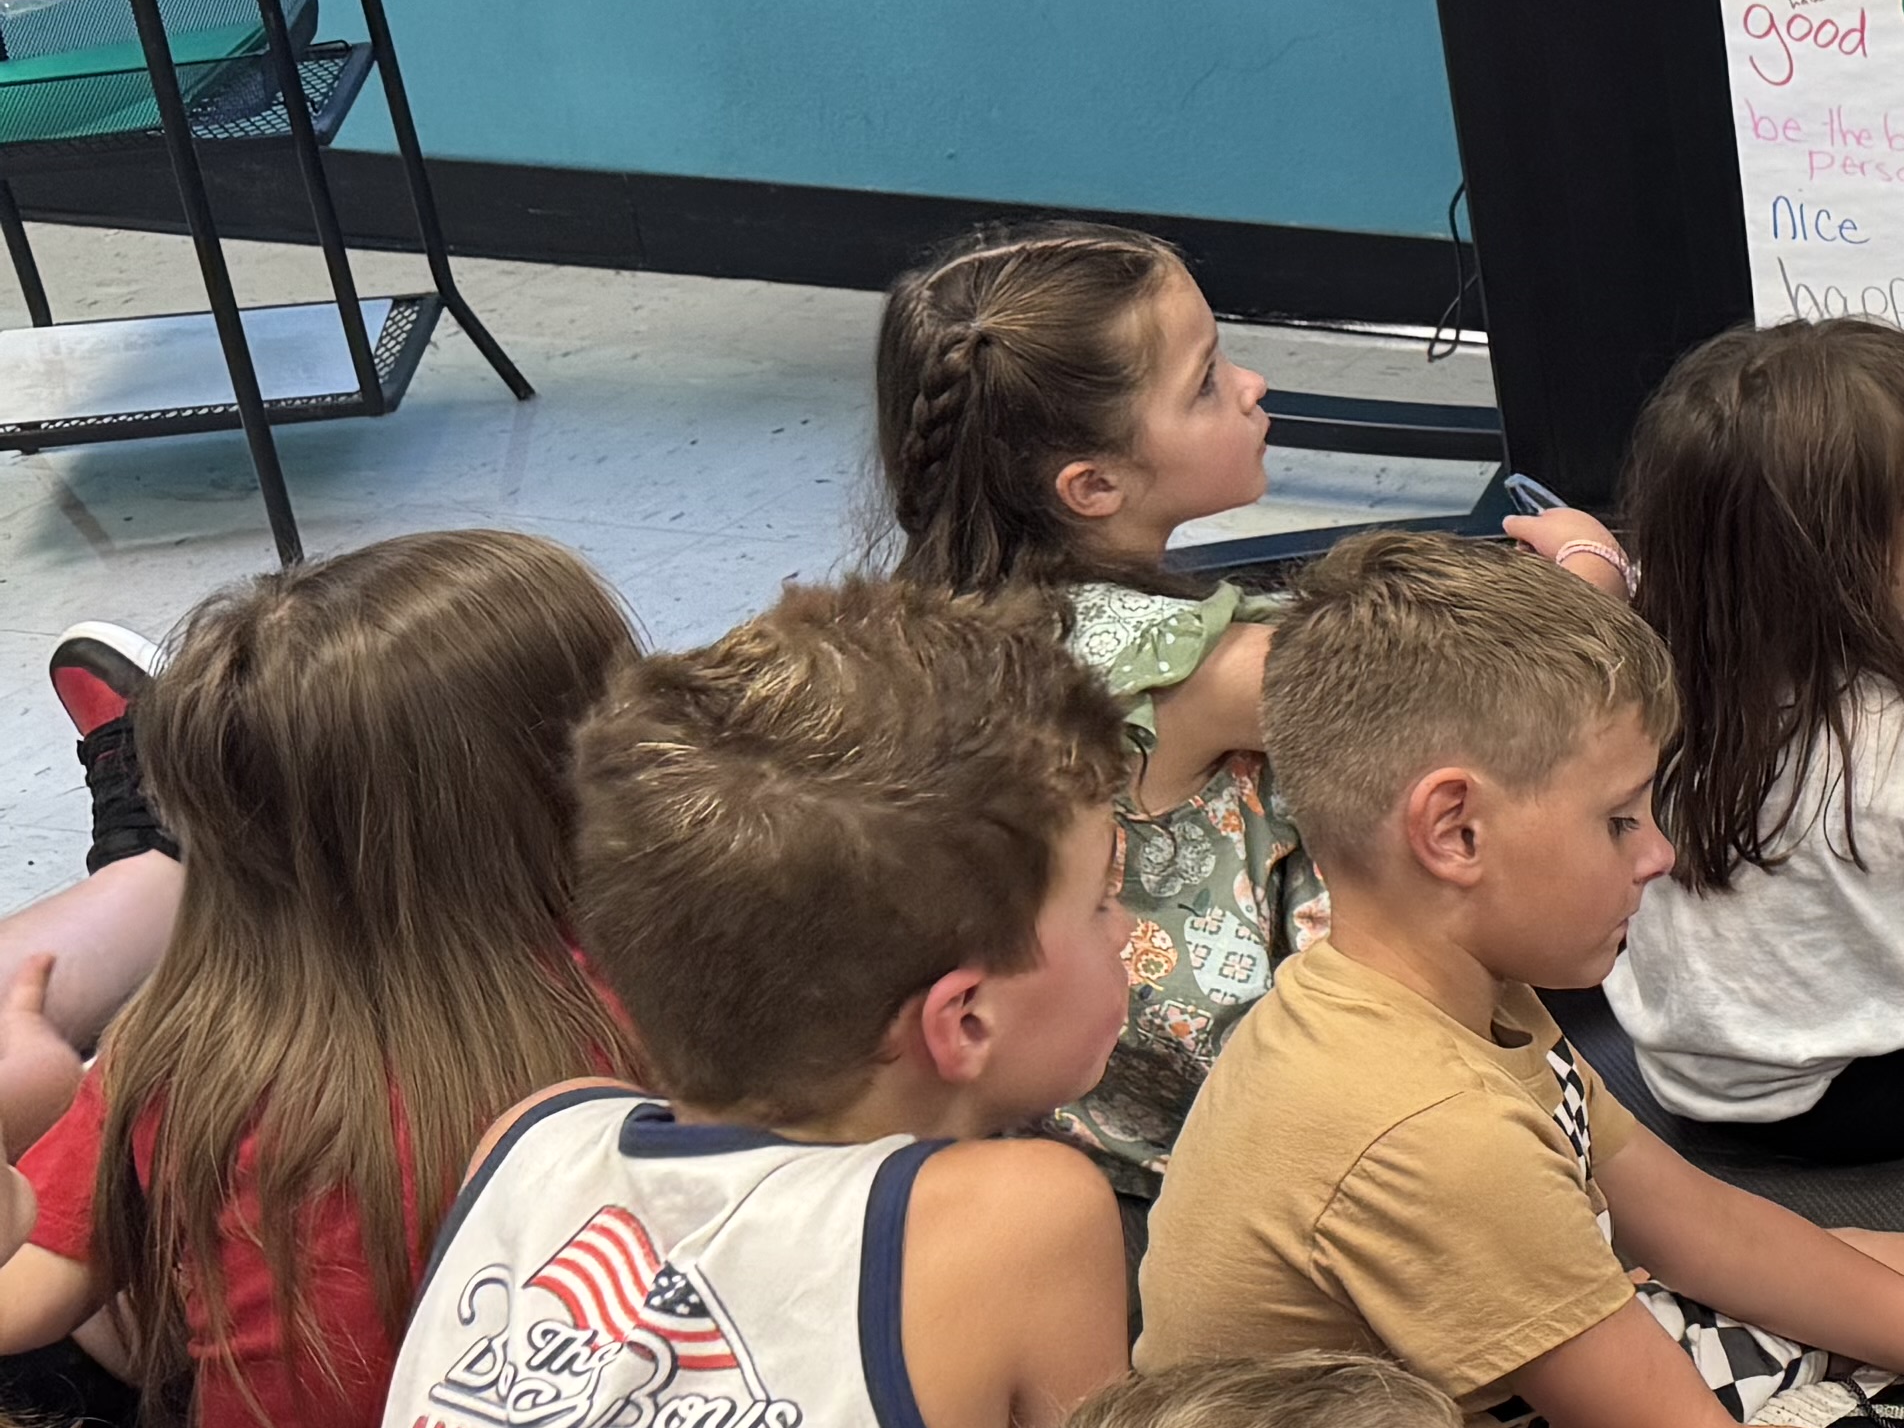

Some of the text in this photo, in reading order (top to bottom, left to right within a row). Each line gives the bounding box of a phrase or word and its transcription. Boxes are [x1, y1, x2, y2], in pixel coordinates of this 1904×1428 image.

[1742, 2, 1868, 86] good
[1744, 98, 1804, 142] be
[1823, 105, 1873, 148] the
[1772, 189, 1871, 244] nice
